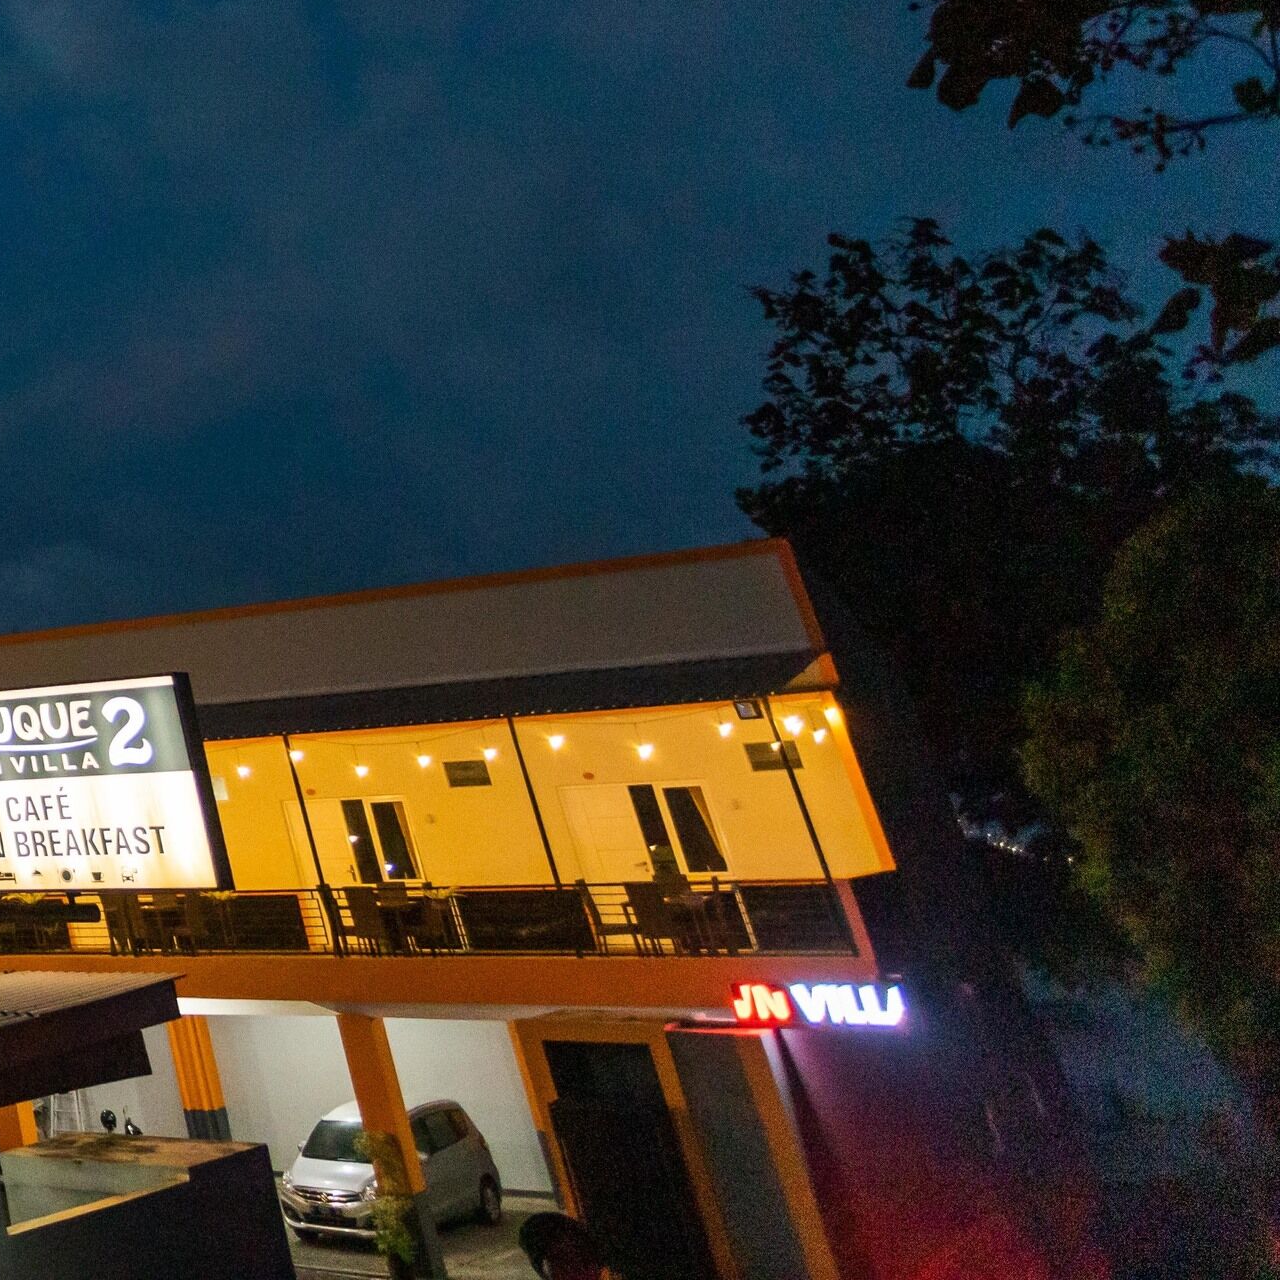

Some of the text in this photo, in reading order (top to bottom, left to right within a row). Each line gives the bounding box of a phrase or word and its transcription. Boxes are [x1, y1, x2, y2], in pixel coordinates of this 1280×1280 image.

[101, 696, 153, 767] 2
[5, 786, 73, 822] CAFÉ
[14, 825, 166, 858] BREAKFAST
